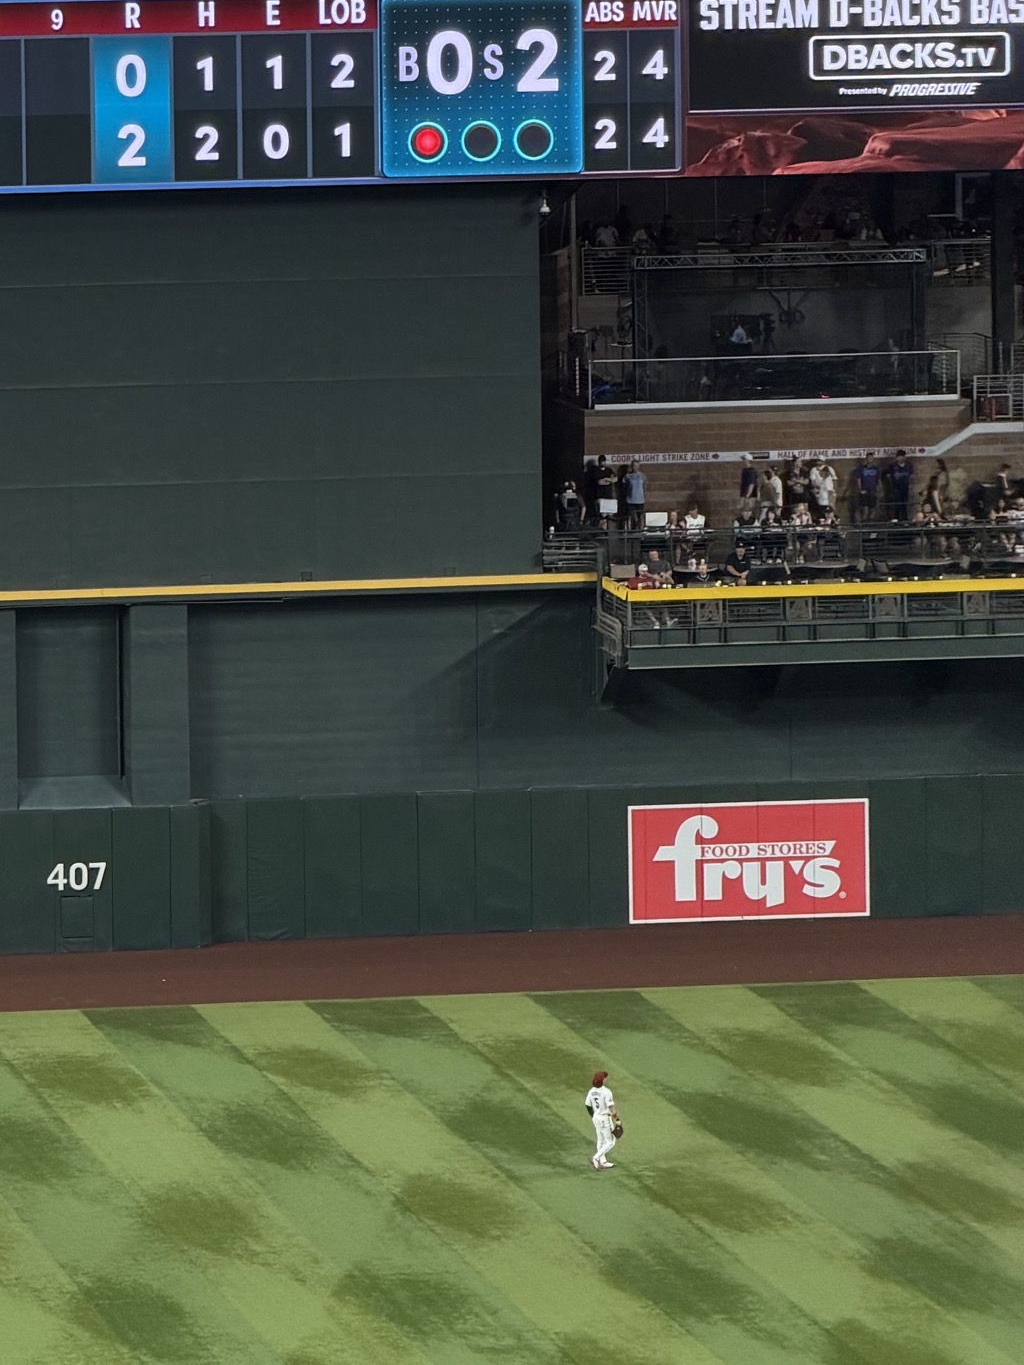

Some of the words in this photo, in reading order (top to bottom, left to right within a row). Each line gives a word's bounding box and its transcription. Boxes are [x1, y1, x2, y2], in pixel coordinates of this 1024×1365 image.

[125, 2, 141, 29] R
[198, 0, 215, 27] H
[266, 0, 281, 26] E
[584, 1, 625, 23] ABS
[632, 0, 677, 22] MVR
[398, 46, 420, 82] B
[426, 29, 473, 95] 0
[483, 43, 504, 81] S
[516, 28, 560, 93] 2
[822, 41, 996, 71] DBACKS.TV
[877, 87, 887, 95] by
[888, 82, 982, 97] PROGRESSIVE
[638, 454, 659, 462] LIGHT
[662, 453, 688, 461] STRIKE
[831, 449, 847, 457] AND
[652, 814, 842, 908] fry's
[700, 845, 750, 858] FOOD
[757, 842, 827, 857] STORES
[46, 861, 107, 891] 407
